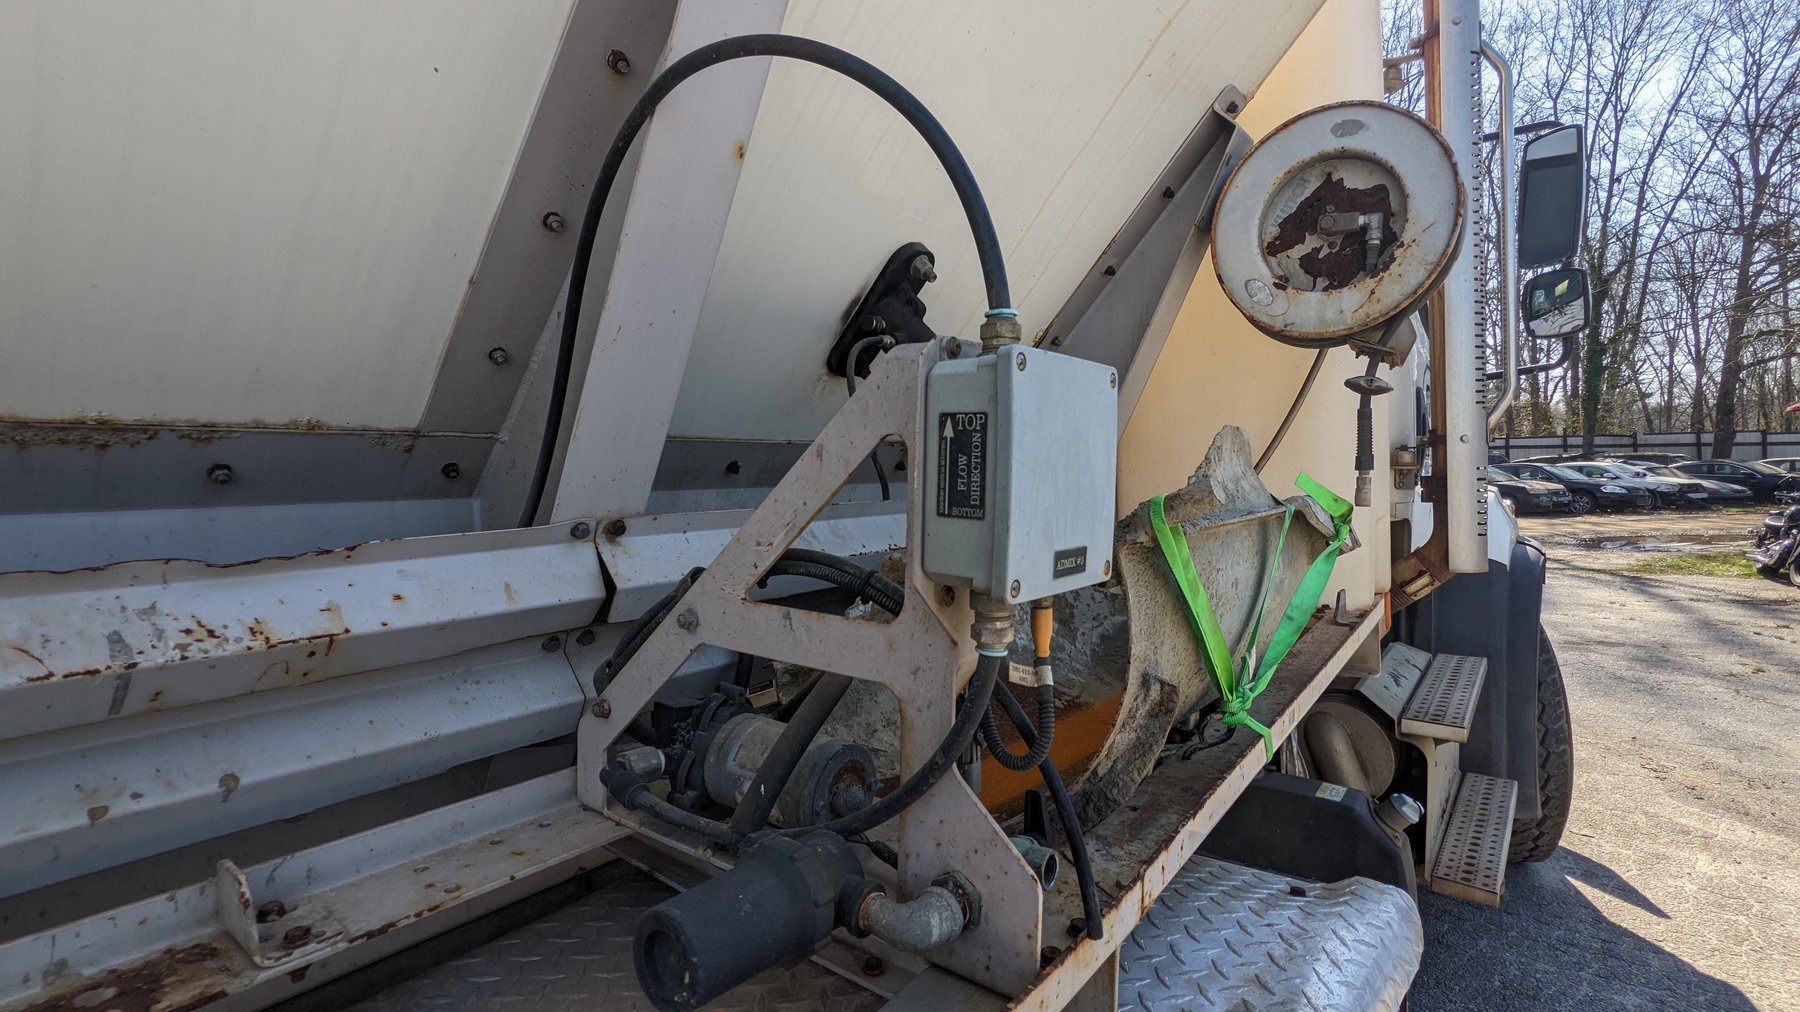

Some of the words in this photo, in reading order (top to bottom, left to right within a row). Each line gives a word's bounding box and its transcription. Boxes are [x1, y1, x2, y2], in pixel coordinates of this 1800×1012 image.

[956, 414, 985, 430] TOP
[957, 453, 968, 491] FLOW
[971, 432, 982, 506] DIRECTION
[952, 507, 984, 518] BOTTOM
[1056, 557, 1077, 570] ADMIX
